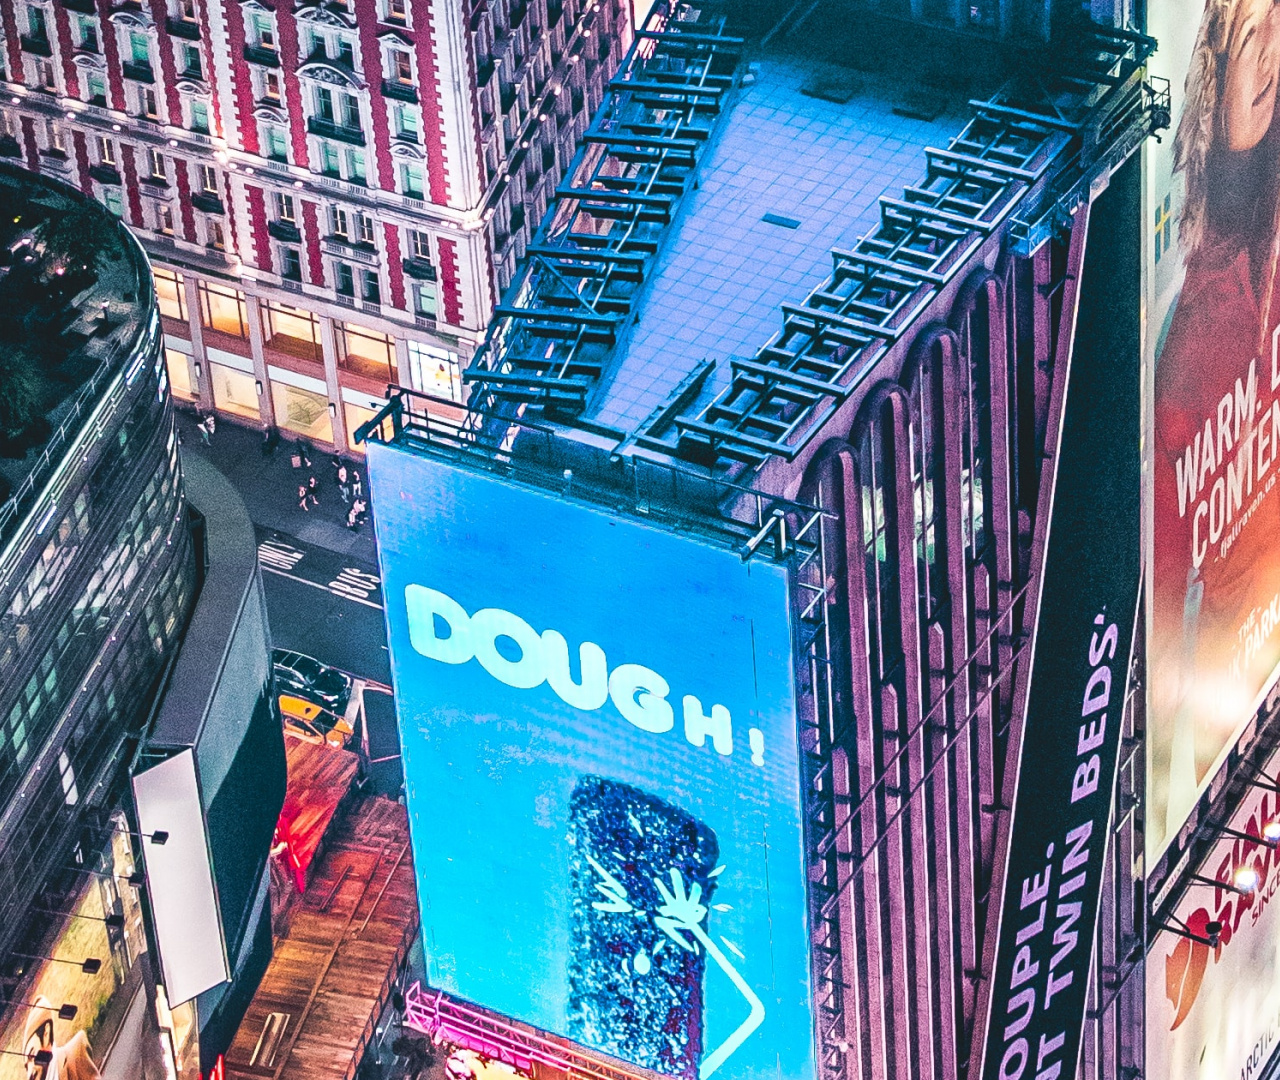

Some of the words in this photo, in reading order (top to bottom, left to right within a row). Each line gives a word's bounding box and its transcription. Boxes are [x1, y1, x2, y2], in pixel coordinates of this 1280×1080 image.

[1175, 357, 1262, 519] WARM.
[998, 842, 1055, 1080] OUPLE.
[1044, 819, 1094, 1010] TWIN
